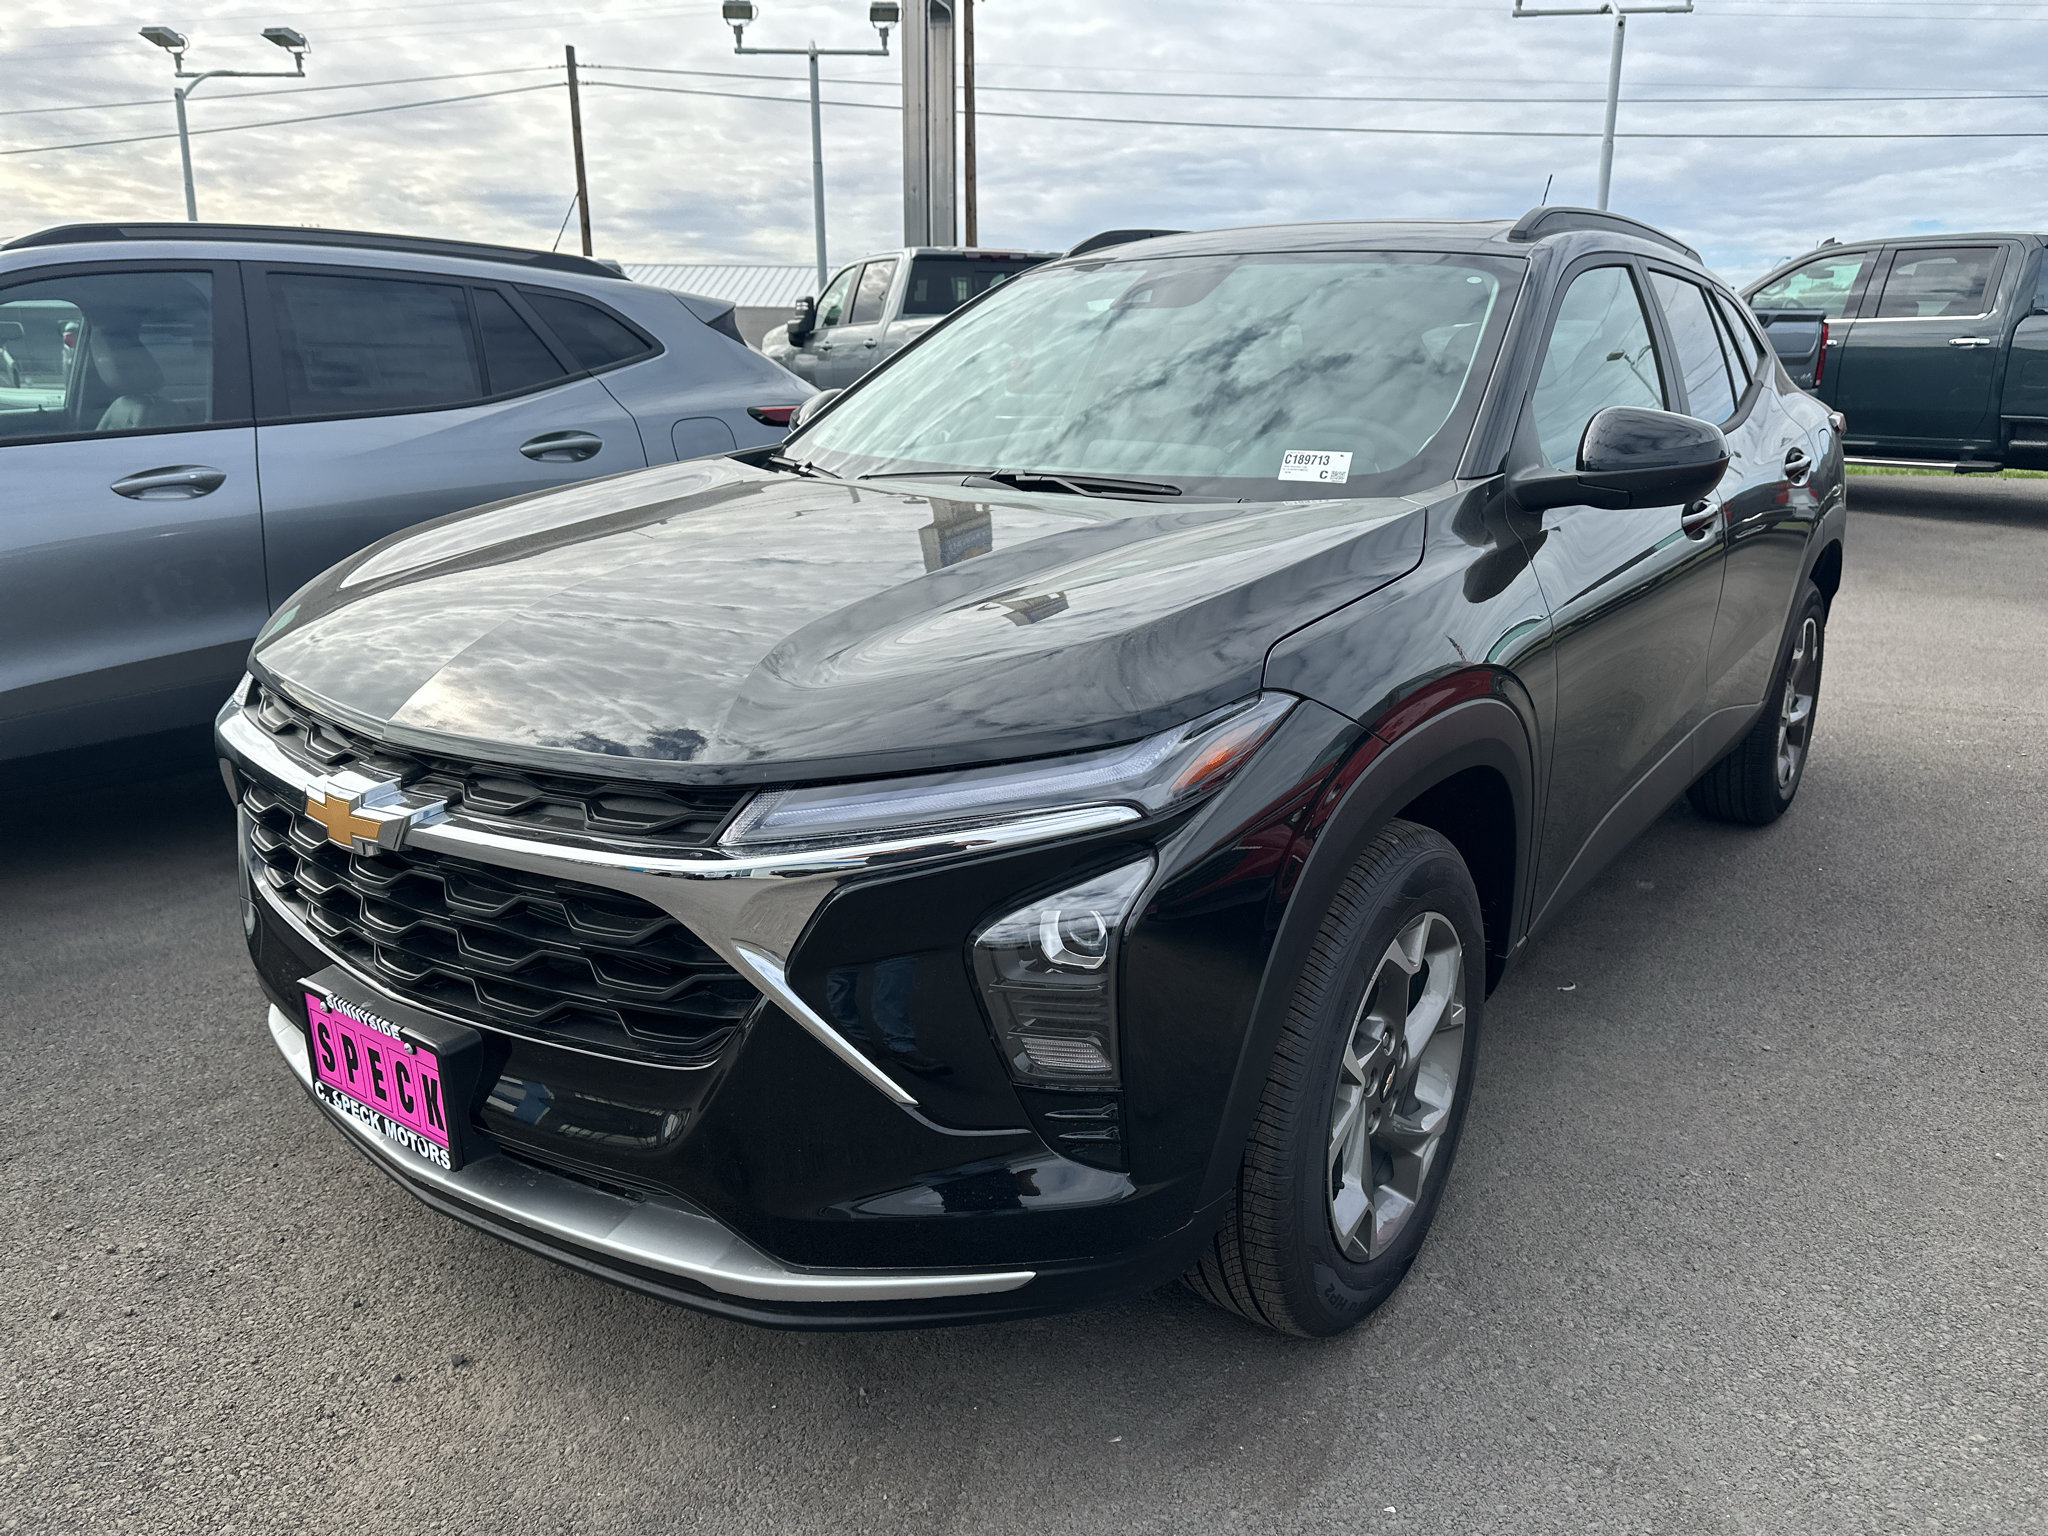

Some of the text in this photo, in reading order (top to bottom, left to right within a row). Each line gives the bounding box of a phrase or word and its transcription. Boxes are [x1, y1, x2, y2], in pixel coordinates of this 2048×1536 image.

[1285, 454, 1330, 465] C189713
[1319, 470, 1328, 479] C
[325, 992, 402, 1041] SUNNYSIDE
[317, 1021, 444, 1131] SPECK
[332, 1092, 382, 1133] SPECK
[384, 1117, 452, 1170] MOTORS
